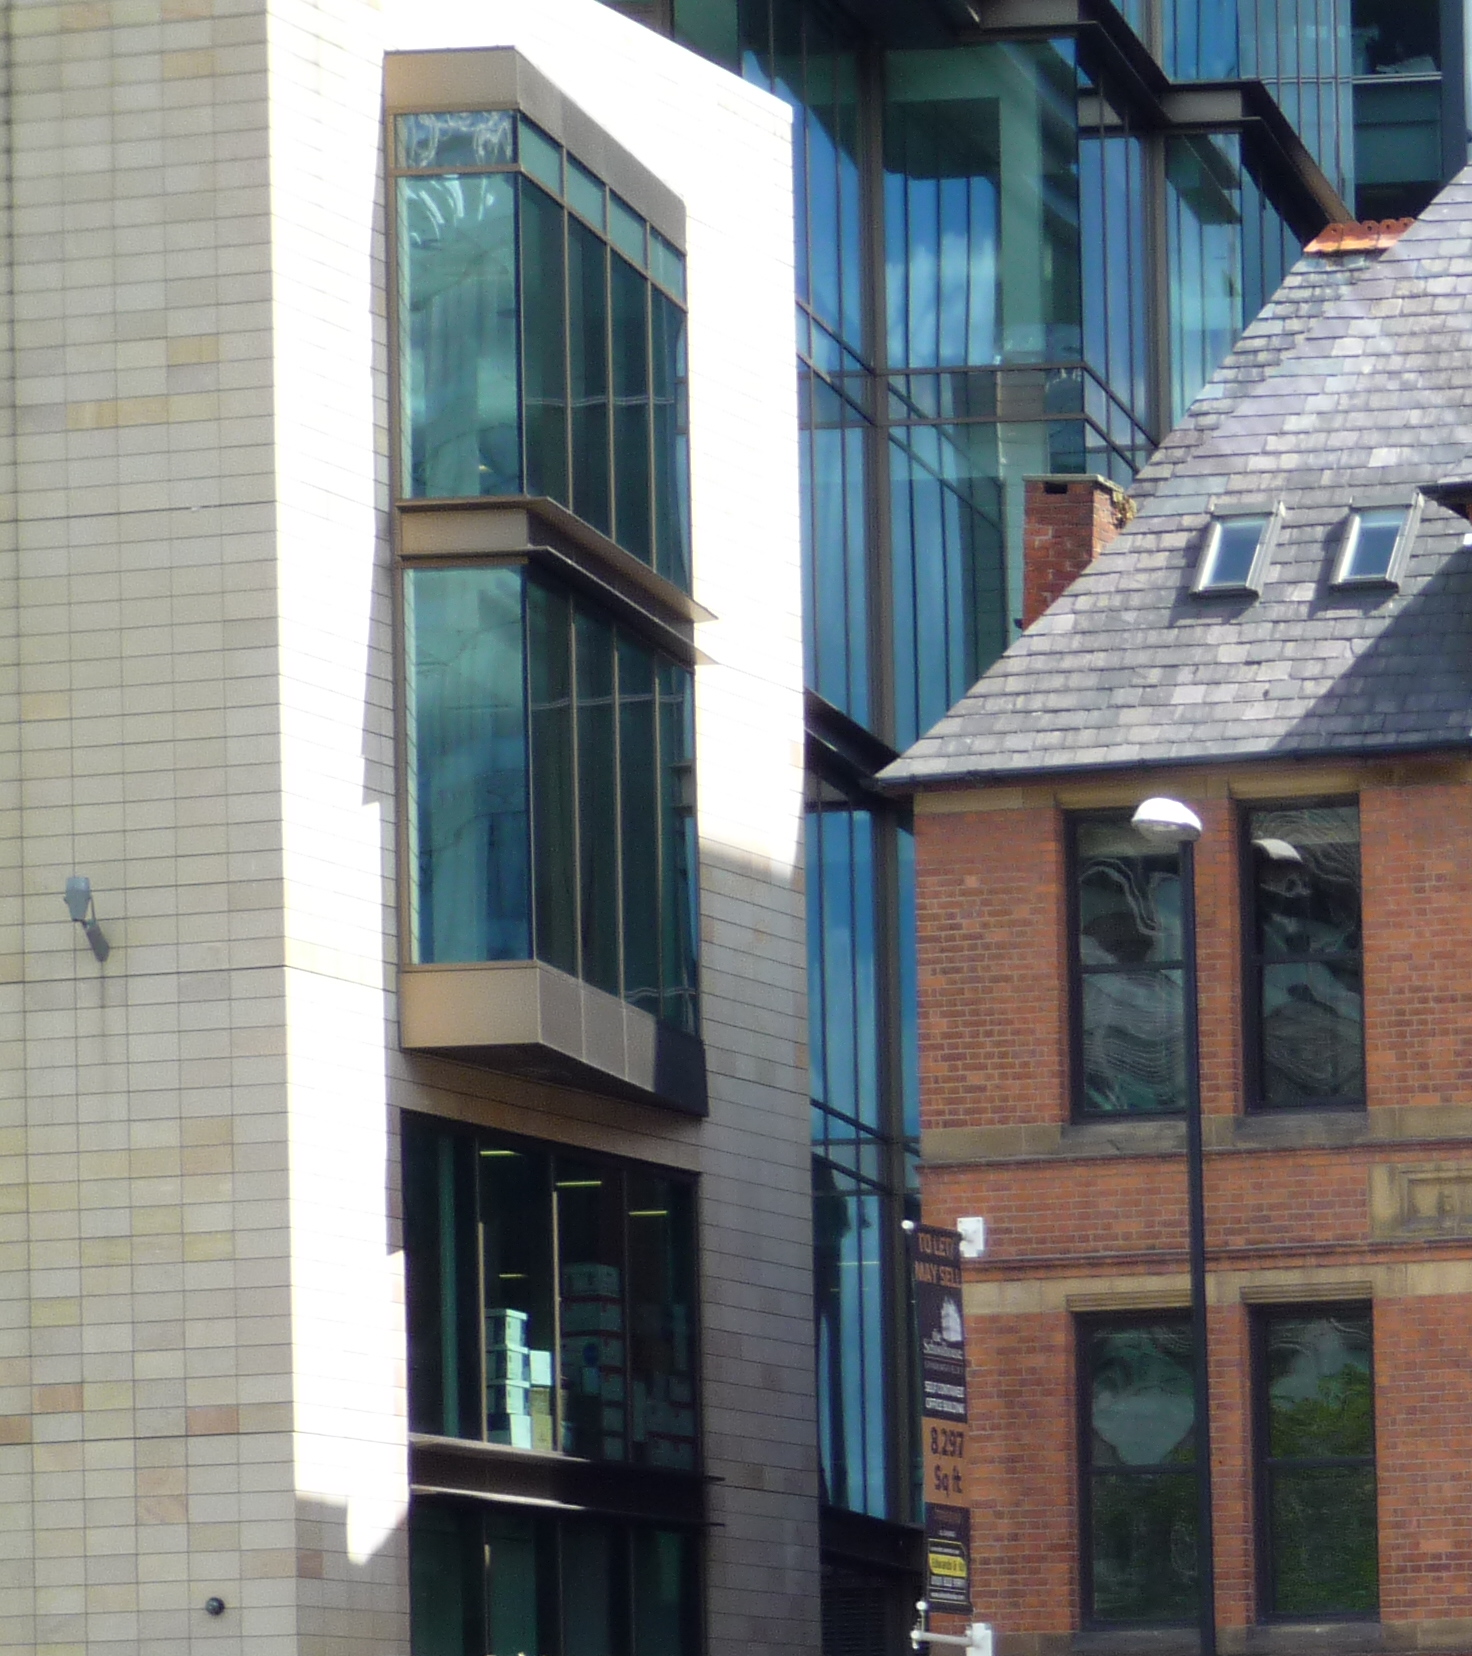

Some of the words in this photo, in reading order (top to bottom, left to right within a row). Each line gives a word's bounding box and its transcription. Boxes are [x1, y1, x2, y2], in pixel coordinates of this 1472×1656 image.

[918, 1232, 932, 1254] TO
[914, 1261, 938, 1283] MAY
[939, 1265, 962, 1289] SELL
[934, 1464, 949, 1498] Sq
